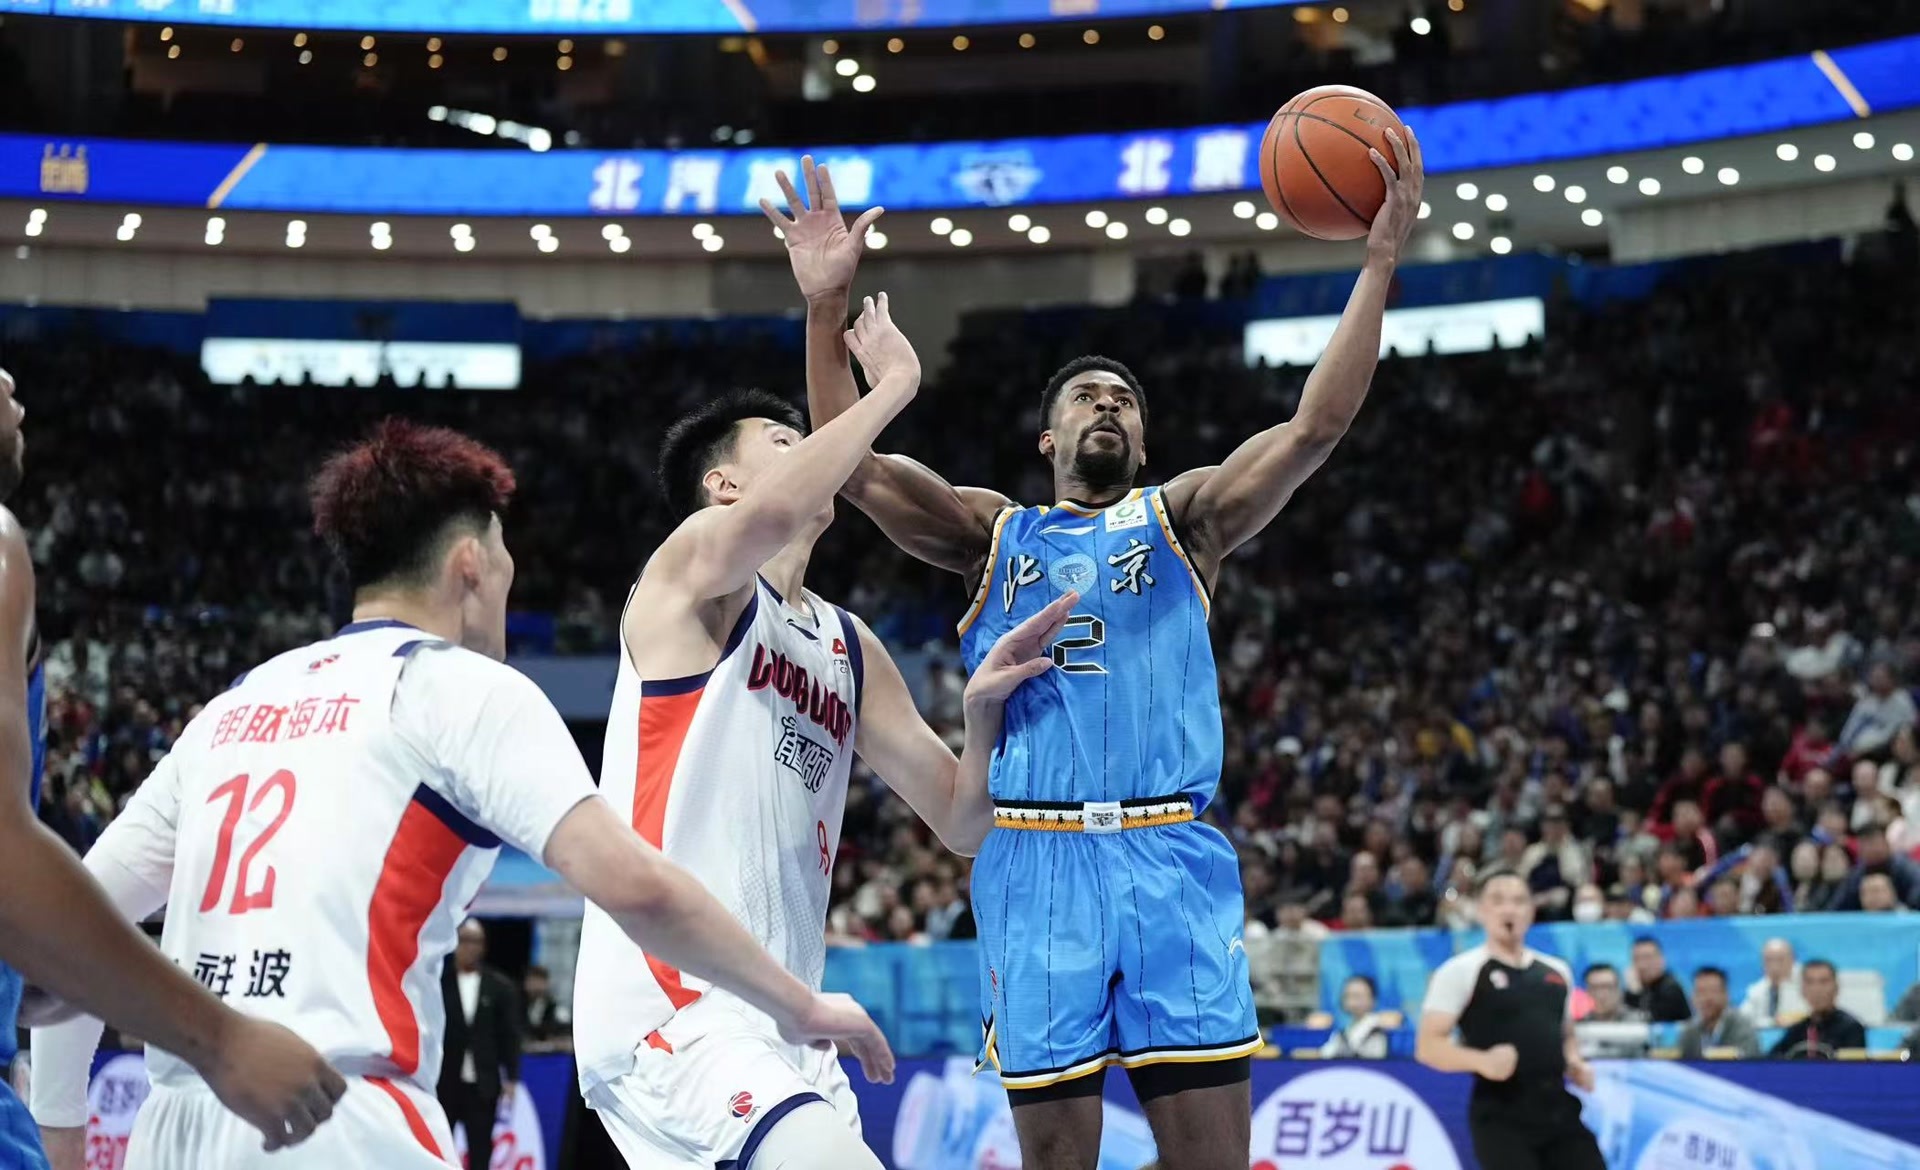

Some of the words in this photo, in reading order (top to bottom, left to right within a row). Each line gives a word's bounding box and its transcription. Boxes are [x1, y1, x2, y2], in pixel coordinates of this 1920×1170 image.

[1052, 613, 1110, 674] 2
[199, 768, 297, 915] 12
[172, 948, 292, 999] 祥波
[1275, 1100, 1413, 1158] 百岁山
